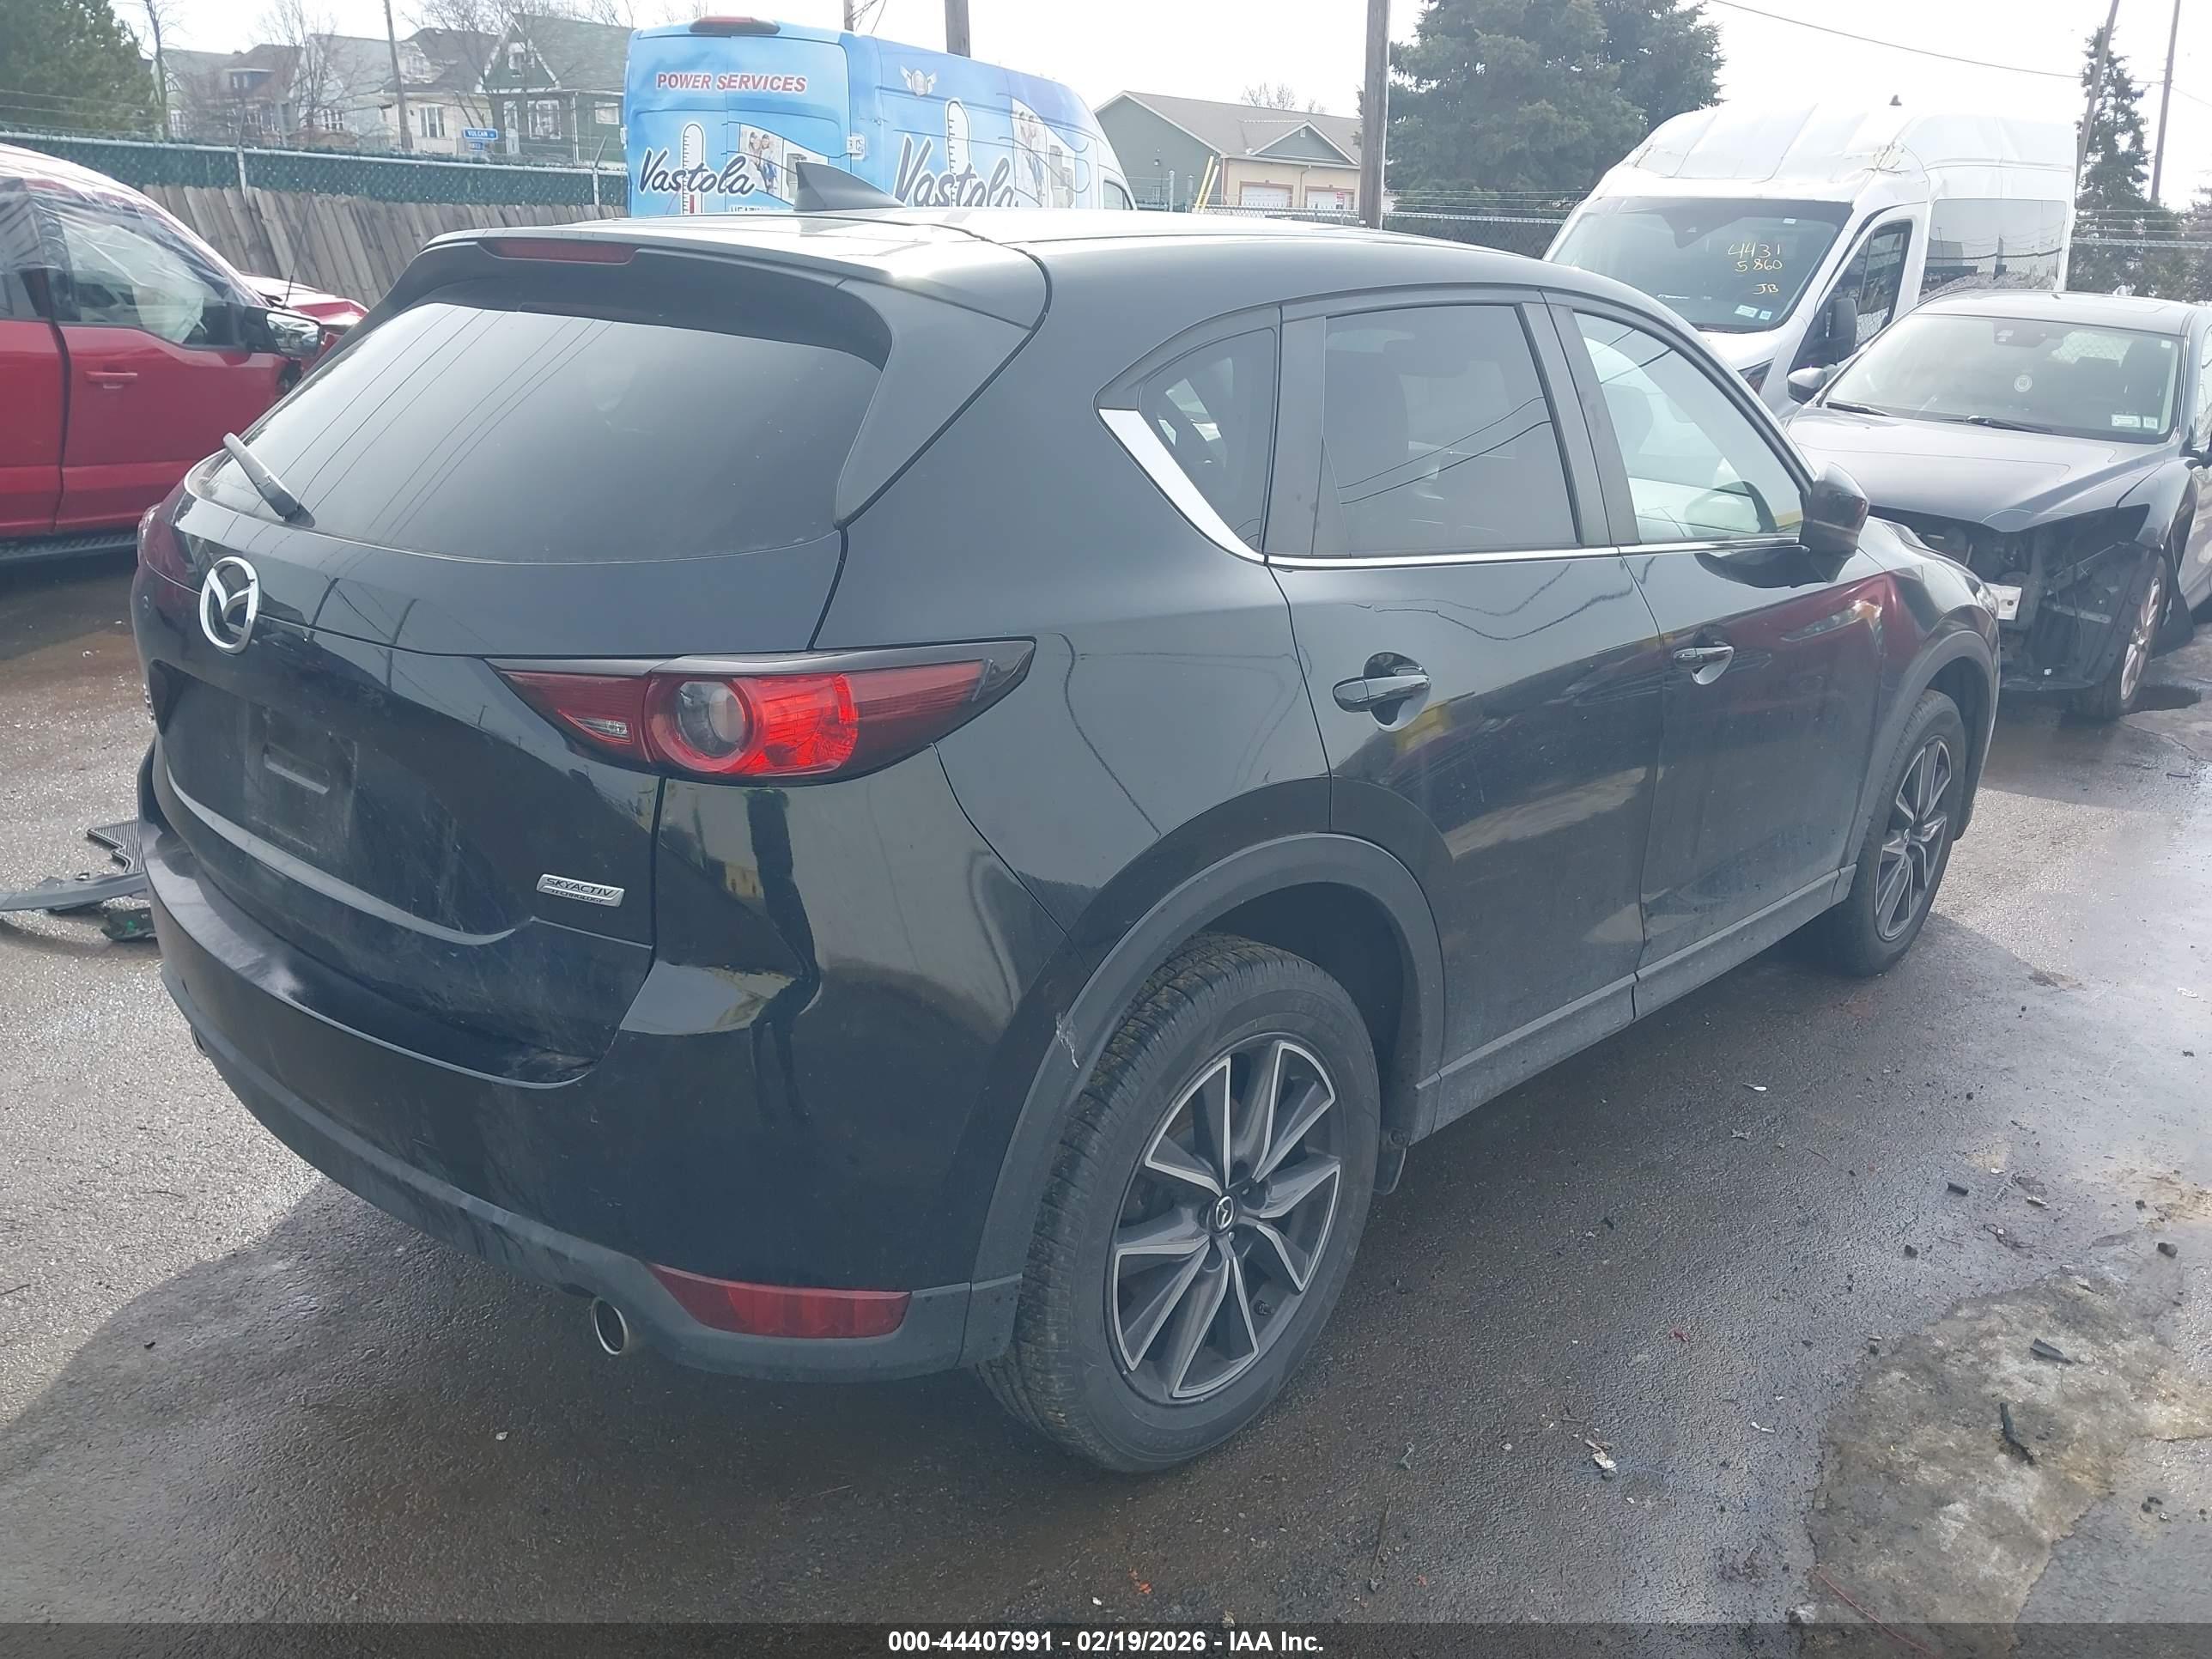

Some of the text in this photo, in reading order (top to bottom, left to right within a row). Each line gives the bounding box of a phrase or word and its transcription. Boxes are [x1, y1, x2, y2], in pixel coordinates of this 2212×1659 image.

[658, 74, 805, 92] POWER SERVICES
[640, 149, 755, 195] Vastola
[1728, 242, 1780, 258] 4431
[1752, 283, 1778, 295] JB
[545, 878, 614, 896] SKYACTIV
[550, 890, 604, 902] TECHNOLOGY
